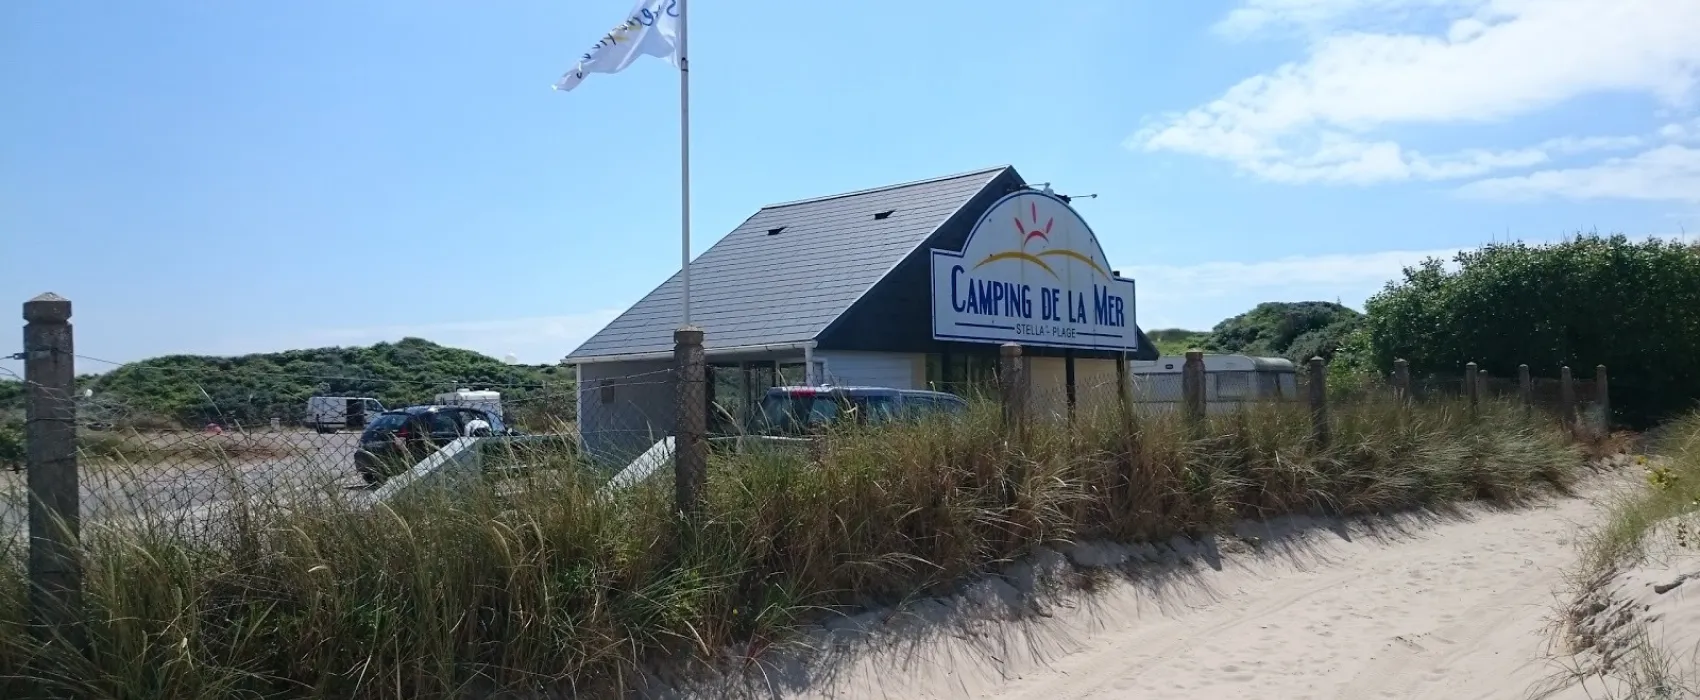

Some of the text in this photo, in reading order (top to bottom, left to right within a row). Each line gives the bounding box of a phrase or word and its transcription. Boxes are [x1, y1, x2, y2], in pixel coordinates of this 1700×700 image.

[951, 265, 1125, 328] CAMPING DE LA MER
